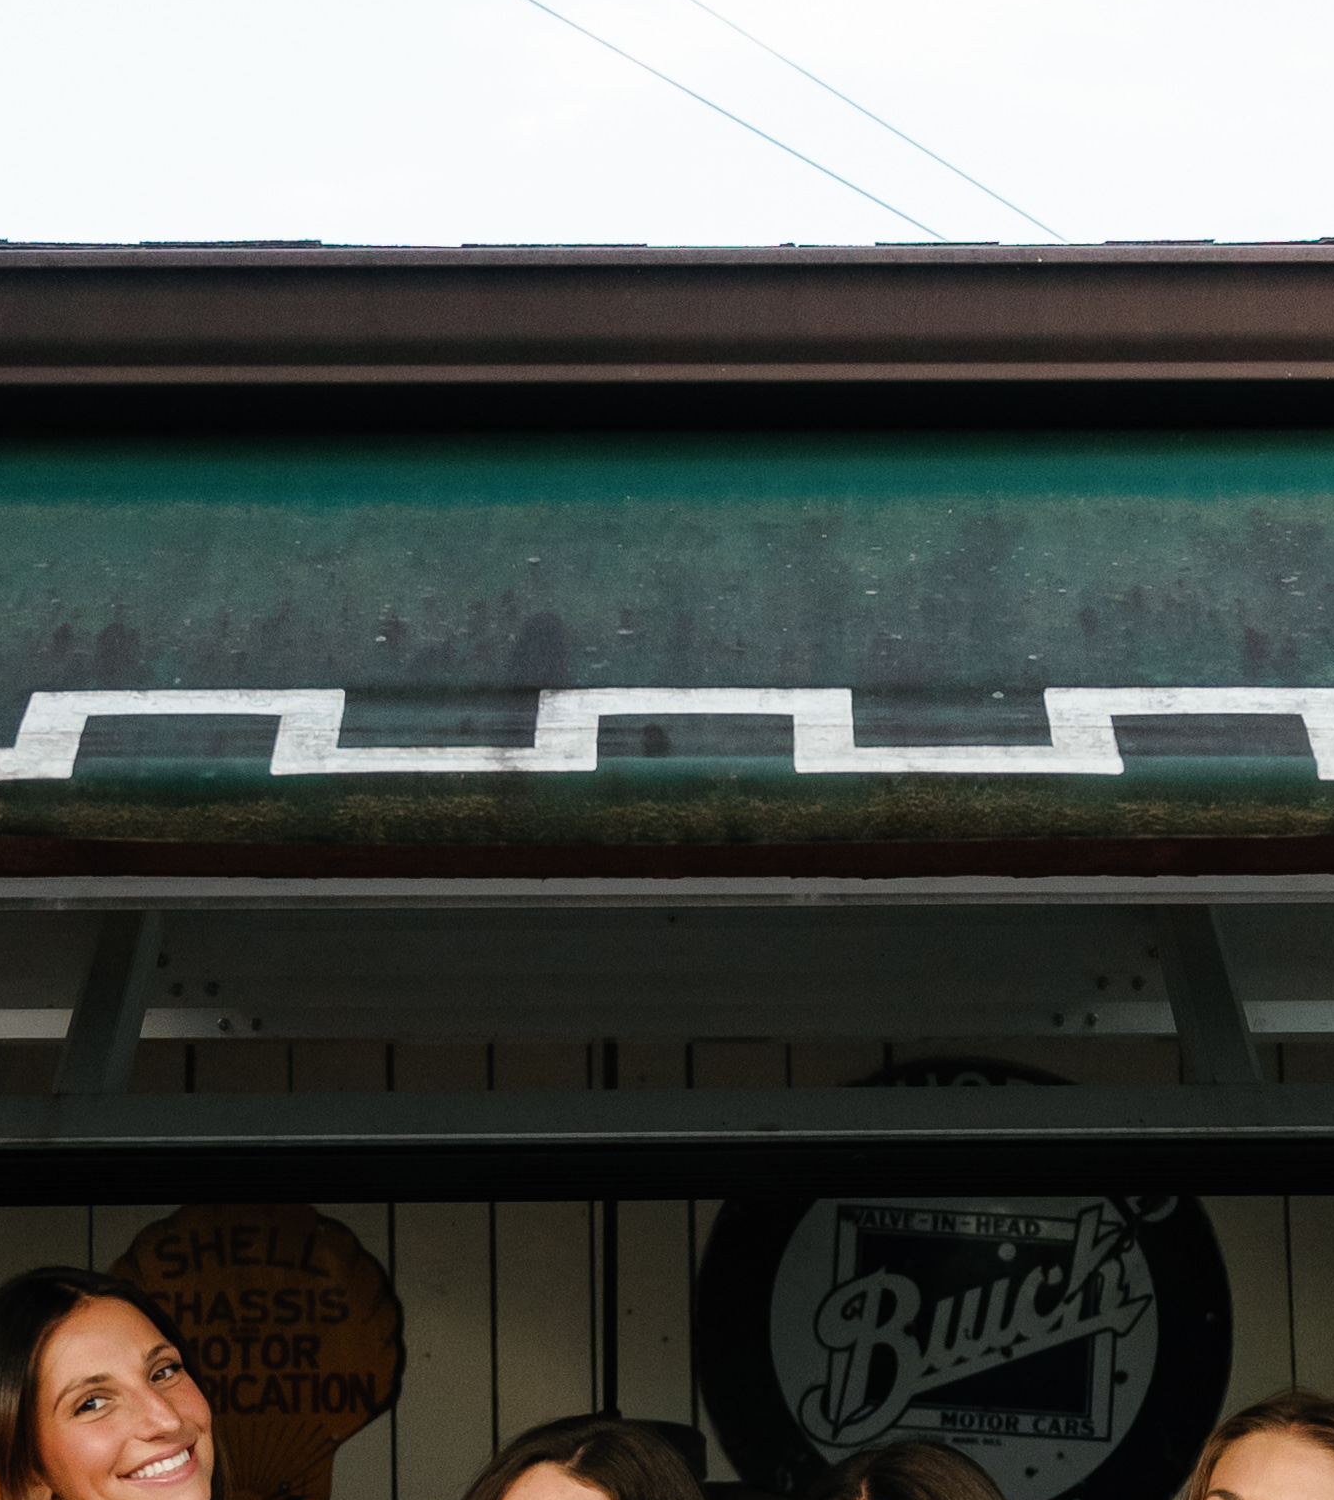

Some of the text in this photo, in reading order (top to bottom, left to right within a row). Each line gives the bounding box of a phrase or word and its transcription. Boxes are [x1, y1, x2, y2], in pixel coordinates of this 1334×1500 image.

[153, 1224, 333, 1280] SHELL
[798, 1202, 1152, 1447] Buick
[940, 1410, 1096, 1439] MOTOR CARS
